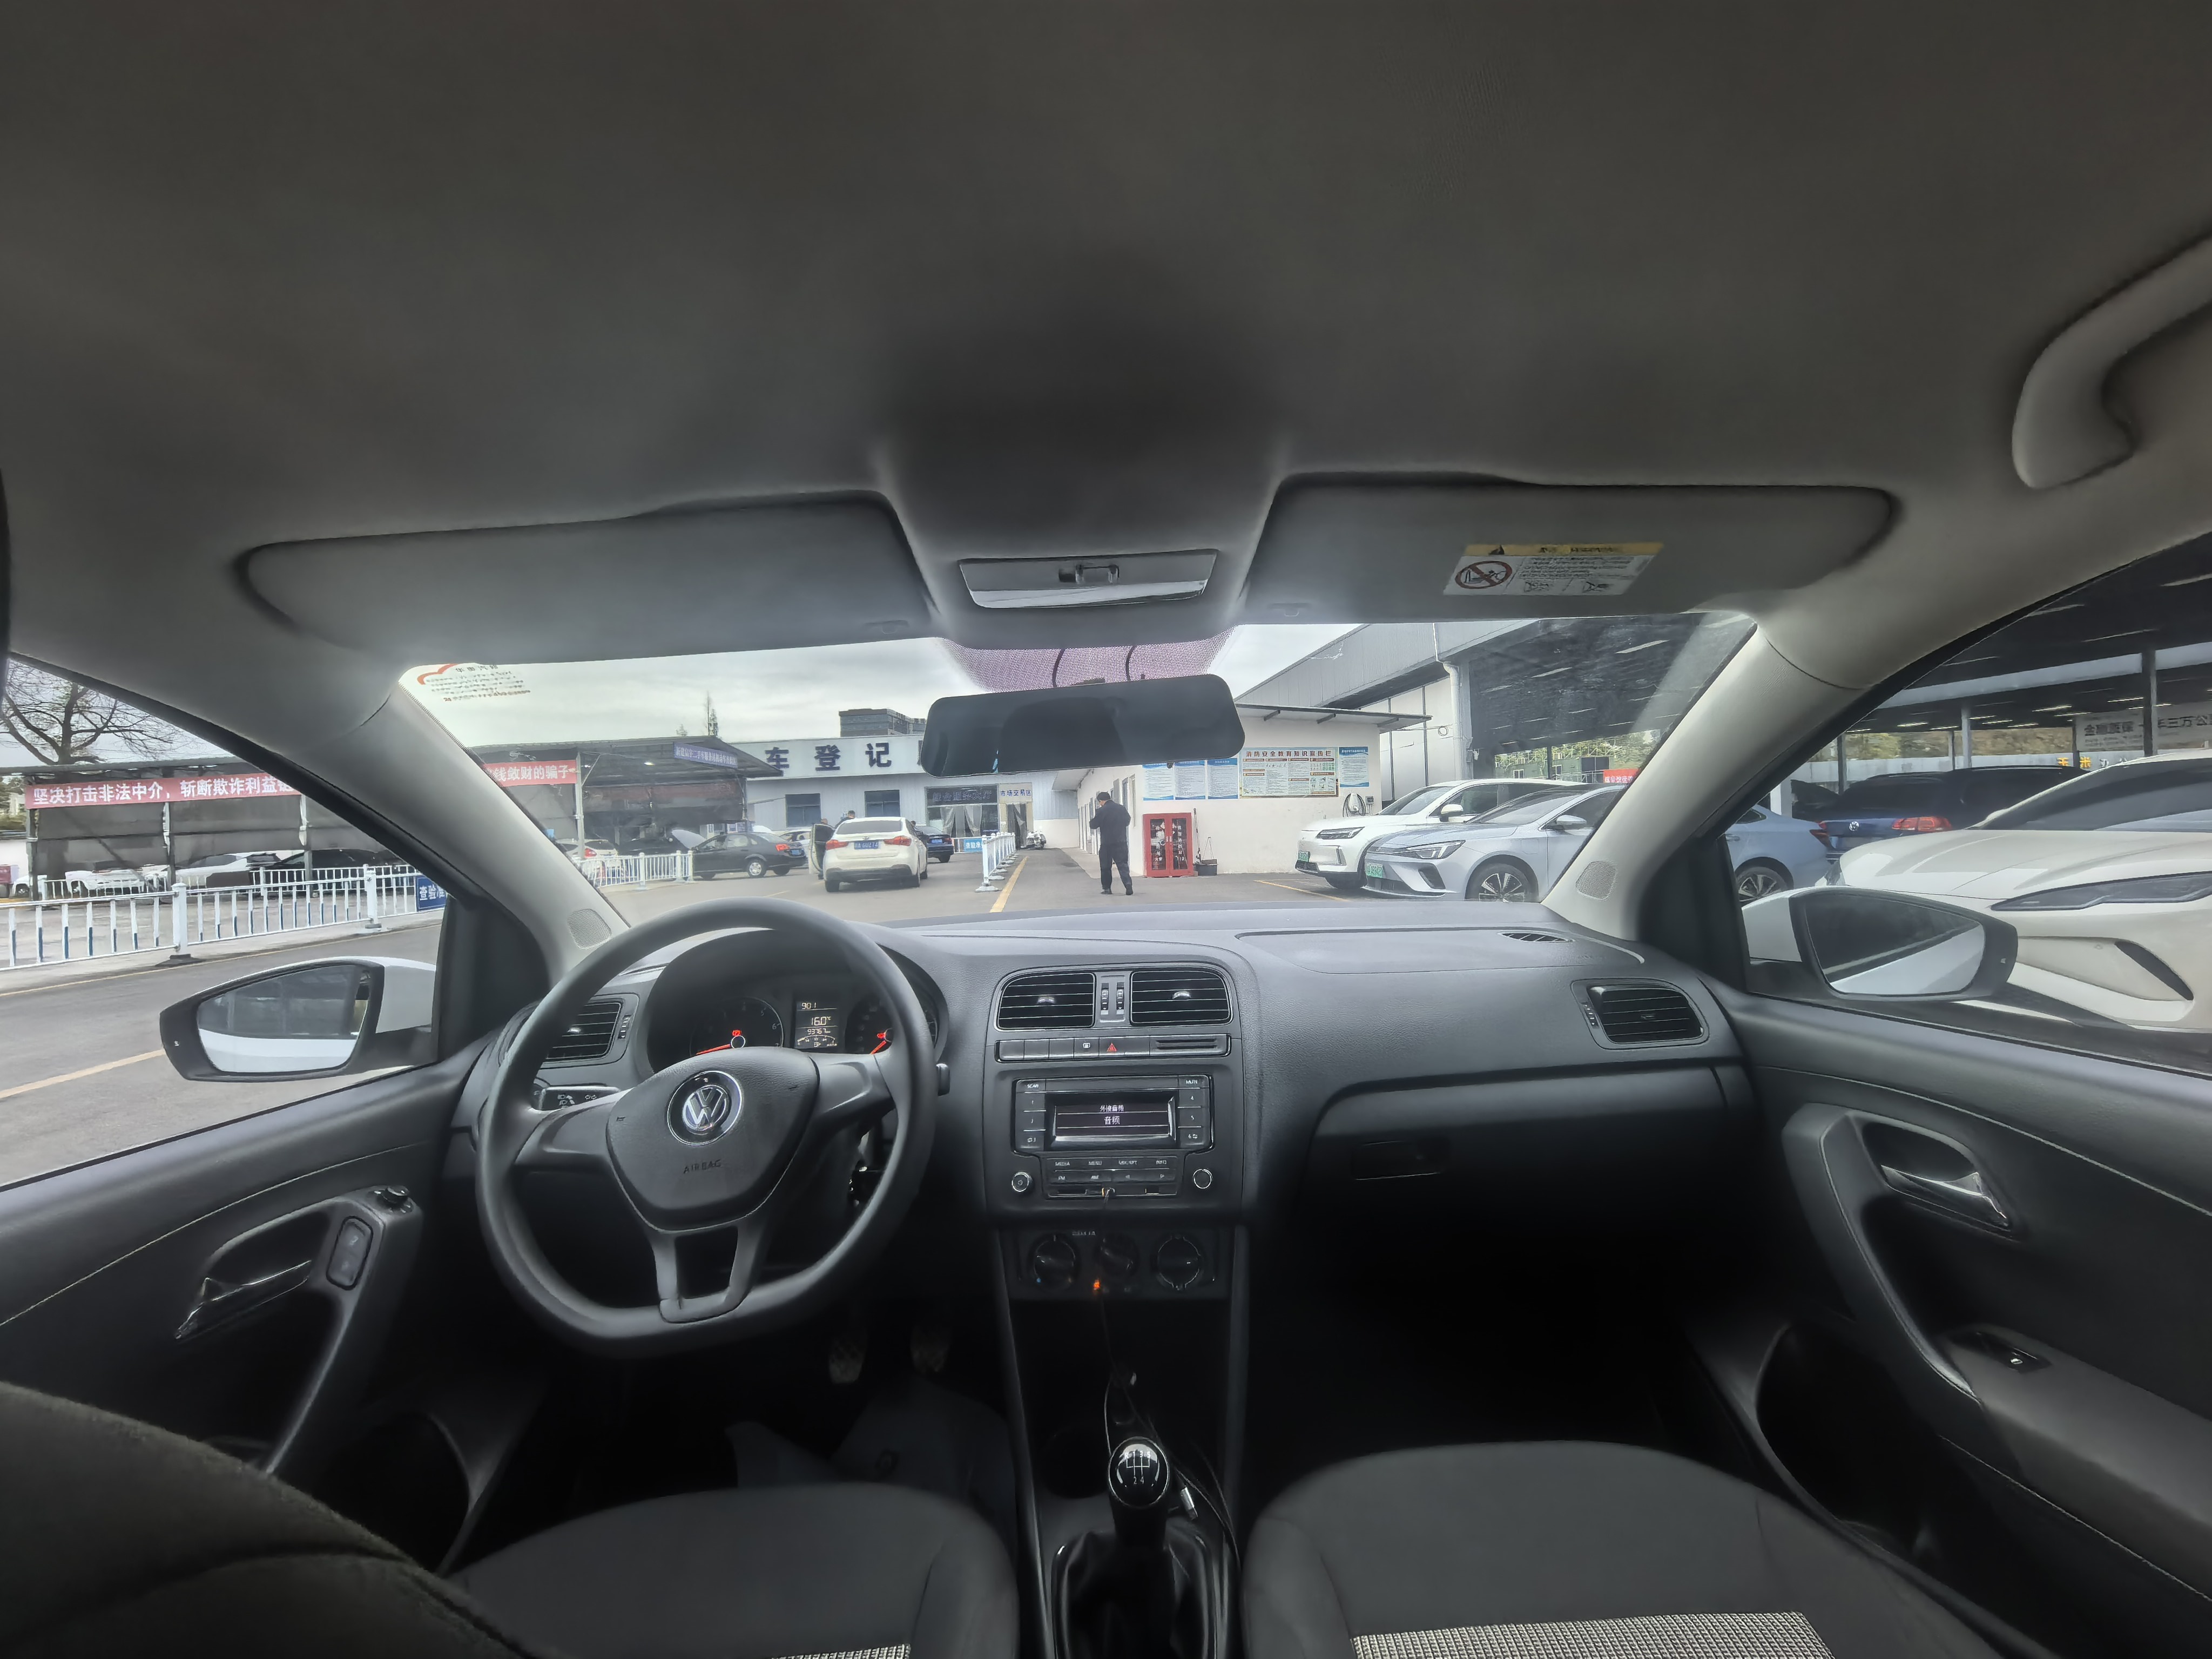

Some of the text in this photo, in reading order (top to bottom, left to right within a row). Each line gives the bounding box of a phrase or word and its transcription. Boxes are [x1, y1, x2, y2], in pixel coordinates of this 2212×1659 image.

[765, 740, 922, 771] 车登记
[484, 765, 569, 782] 钱敛财的骗子
[1104, 1116, 1121, 1125] 音频
[683, 1159, 721, 1174] AIRBAG
